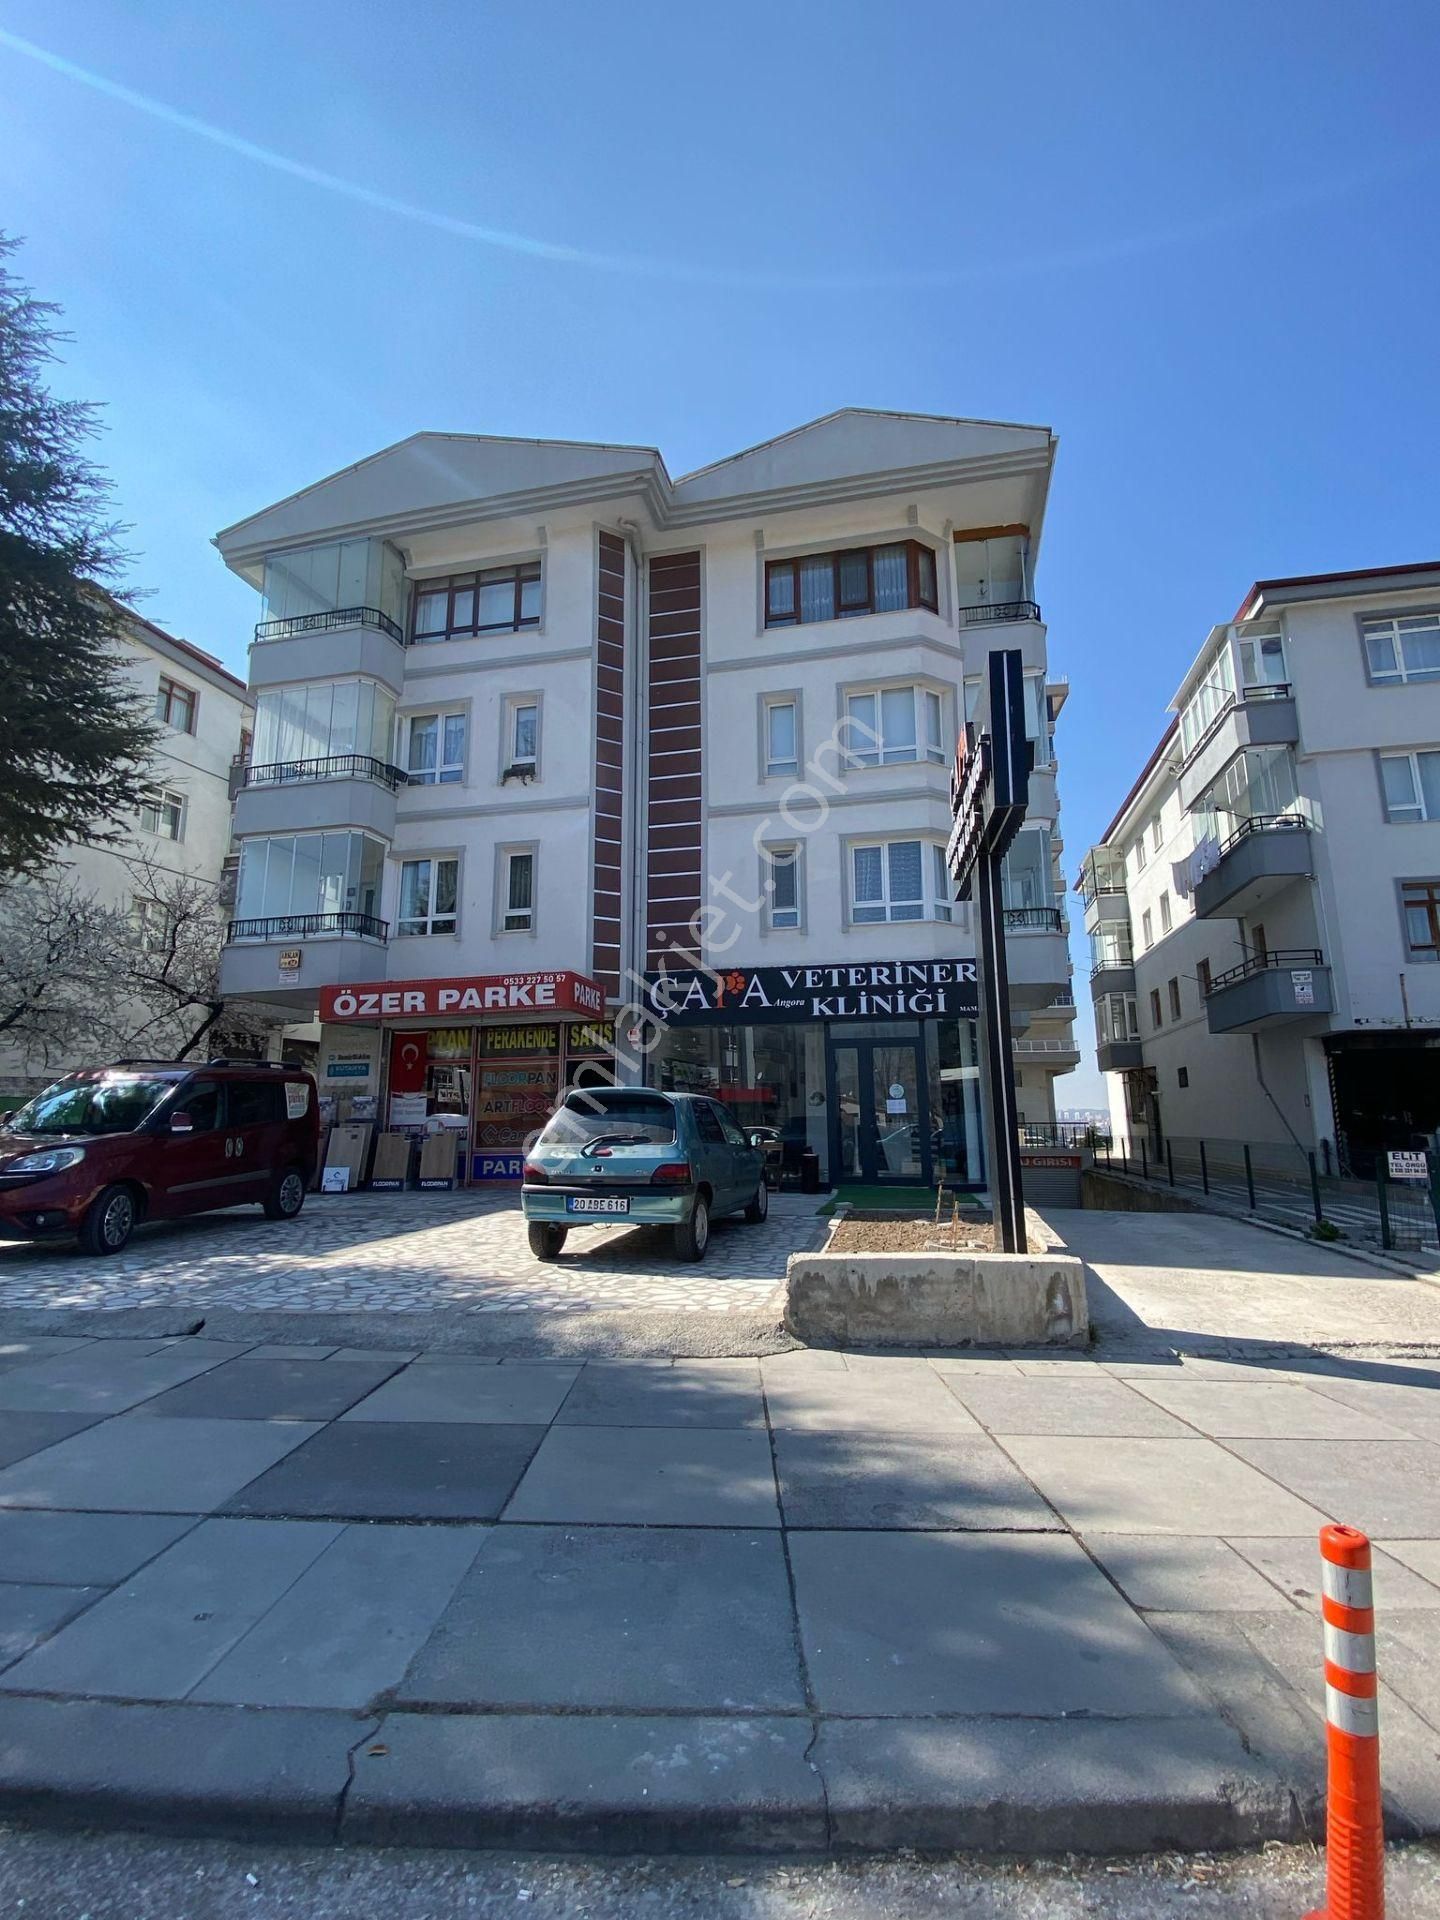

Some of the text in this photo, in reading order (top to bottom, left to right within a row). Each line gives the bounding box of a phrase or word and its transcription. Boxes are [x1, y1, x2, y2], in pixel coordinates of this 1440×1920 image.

[503, 974, 566, 986] 0533 227 50 57
[780, 962, 978, 988] VETERİNER
[333, 983, 556, 1016] ÖZER PARKE
[574, 981, 600, 1011] PARKE
[650, 968, 773, 1019] ÇAPA
[774, 998, 805, 1008] Angora
[812, 988, 948, 1016] KLİNİĞİ
[486, 1027, 556, 1050] PERAKENDE
[574, 1199, 626, 1211] 20 ABE 616
